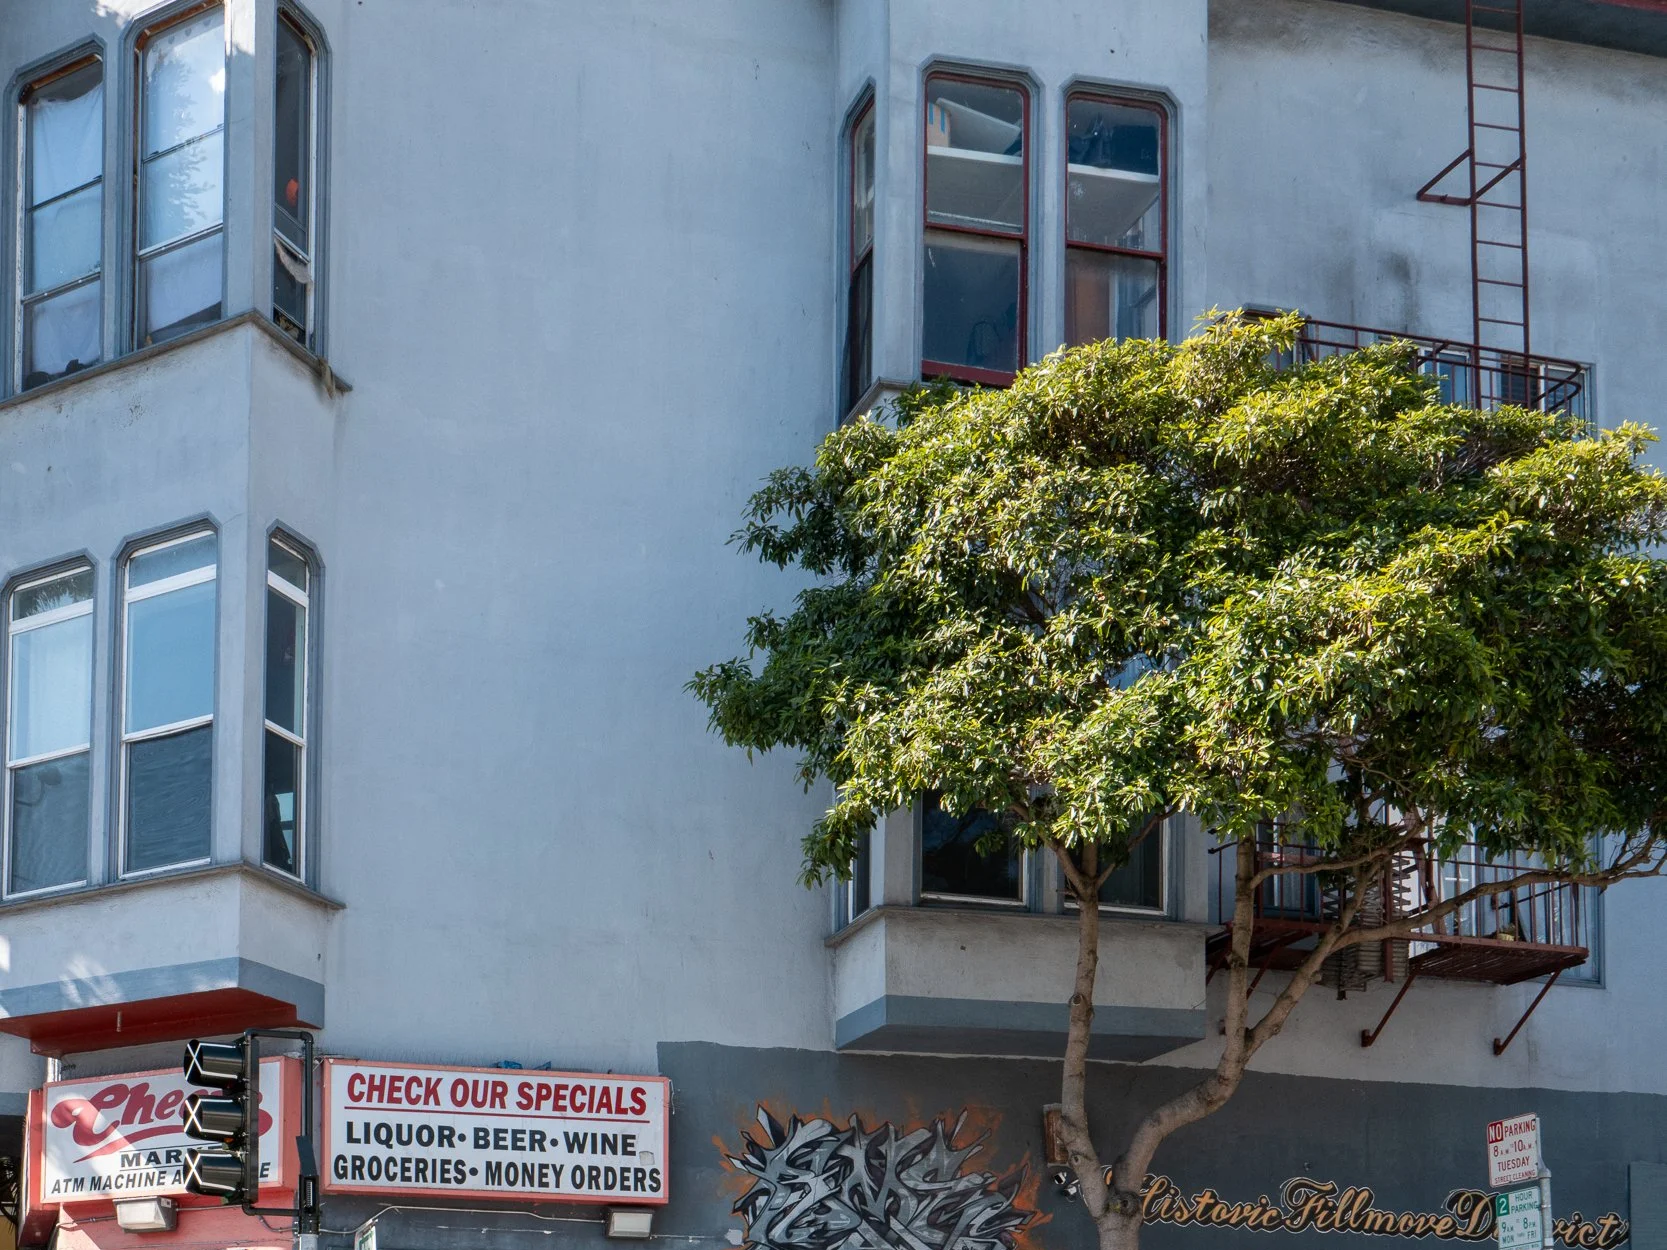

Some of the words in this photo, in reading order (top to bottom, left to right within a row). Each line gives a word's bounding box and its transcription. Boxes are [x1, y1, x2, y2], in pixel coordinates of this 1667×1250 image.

[347, 1072, 443, 1107] CHECK
[449, 1077, 509, 1110] OUR
[515, 1081, 648, 1116] SPECIALS
[51, 1082, 273, 1147] Che
[346, 1120, 456, 1150] LIQUOR
[473, 1126, 547, 1153] BEER
[563, 1131, 637, 1156] WINE
[1488, 1123, 1503, 1142] NO
[1504, 1119, 1536, 1138] PARKING
[120, 1146, 222, 1169] MAR
[1497, 1156, 1530, 1172] TUESDAY
[51, 1176, 84, 1195] ATM
[89, 1170, 168, 1192] MACHINE
[333, 1154, 467, 1185] GROCERIES
[485, 1160, 565, 1189] MONEY
[571, 1164, 662, 1193] ORDERS
[1494, 1175, 1512, 1184] STREET
[1512, 1169, 1536, 1181] CLEANING
[1282, 1176, 1457, 1241] Fillmore
[1449, 1188, 1629, 1250] Drict
[1499, 1198, 1507, 1214] 2
[1514, 1191, 1533, 1202] HOUR
[1511, 1201, 1538, 1214] PARKING
[1502, 1234, 1514, 1244] MON
[1527, 1231, 1537, 1240] FRI
